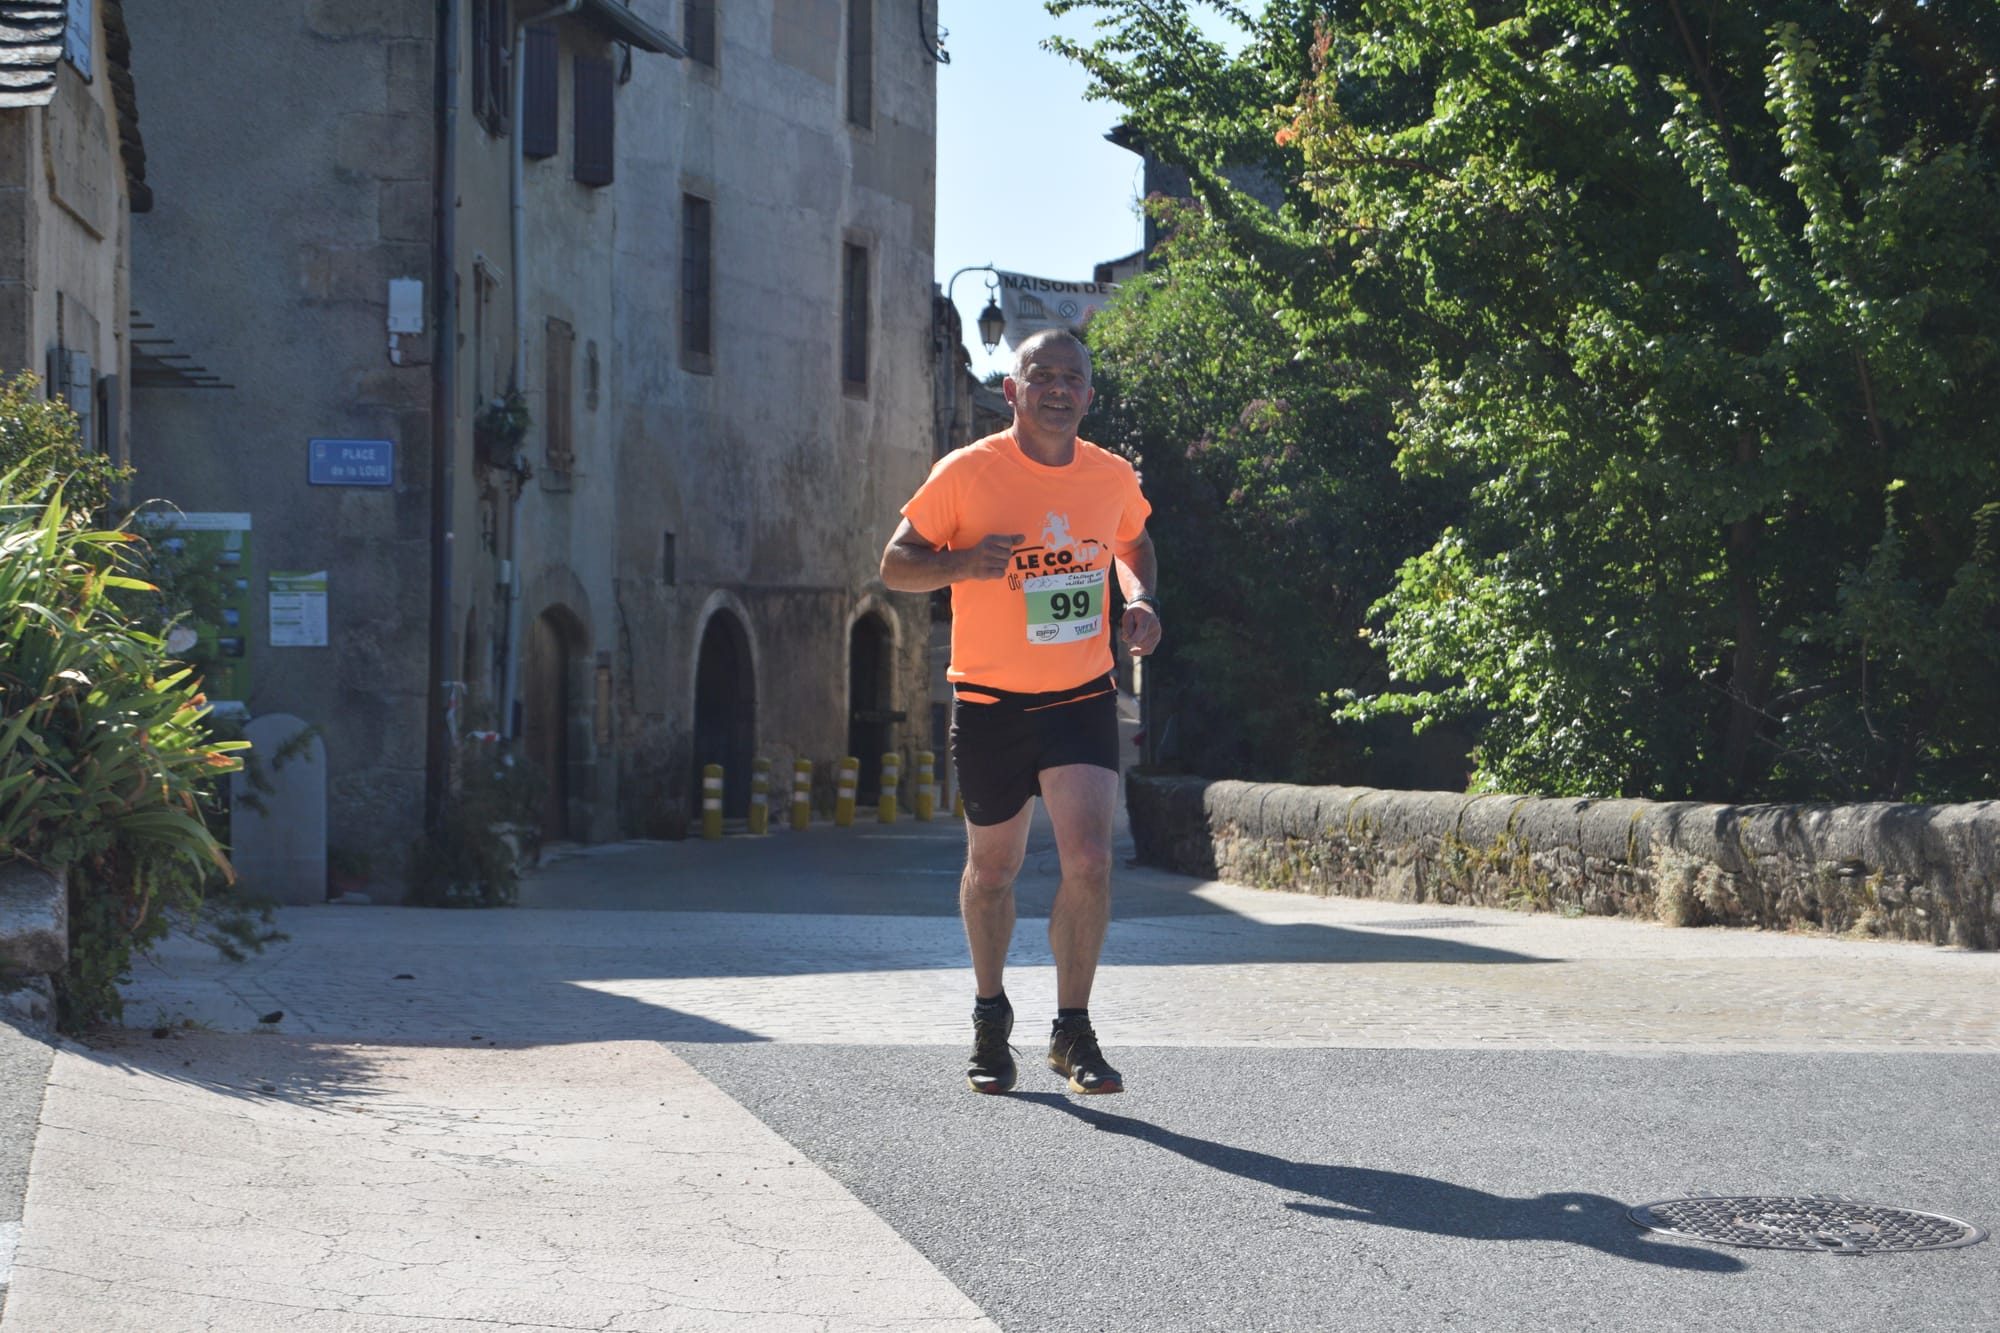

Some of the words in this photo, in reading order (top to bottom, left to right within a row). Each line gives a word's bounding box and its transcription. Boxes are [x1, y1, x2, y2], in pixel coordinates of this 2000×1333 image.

[1004, 276, 1079, 293] MAISON
[1084, 282, 1108, 295] DE
[341, 448, 376, 461] PLACE
[330, 465, 344, 476] de
[1015, 554, 1040, 570] LE
[1044, 547, 1099, 566] COUP
[1008, 573, 1022, 590] de
[1050, 590, 1090, 620] 99
